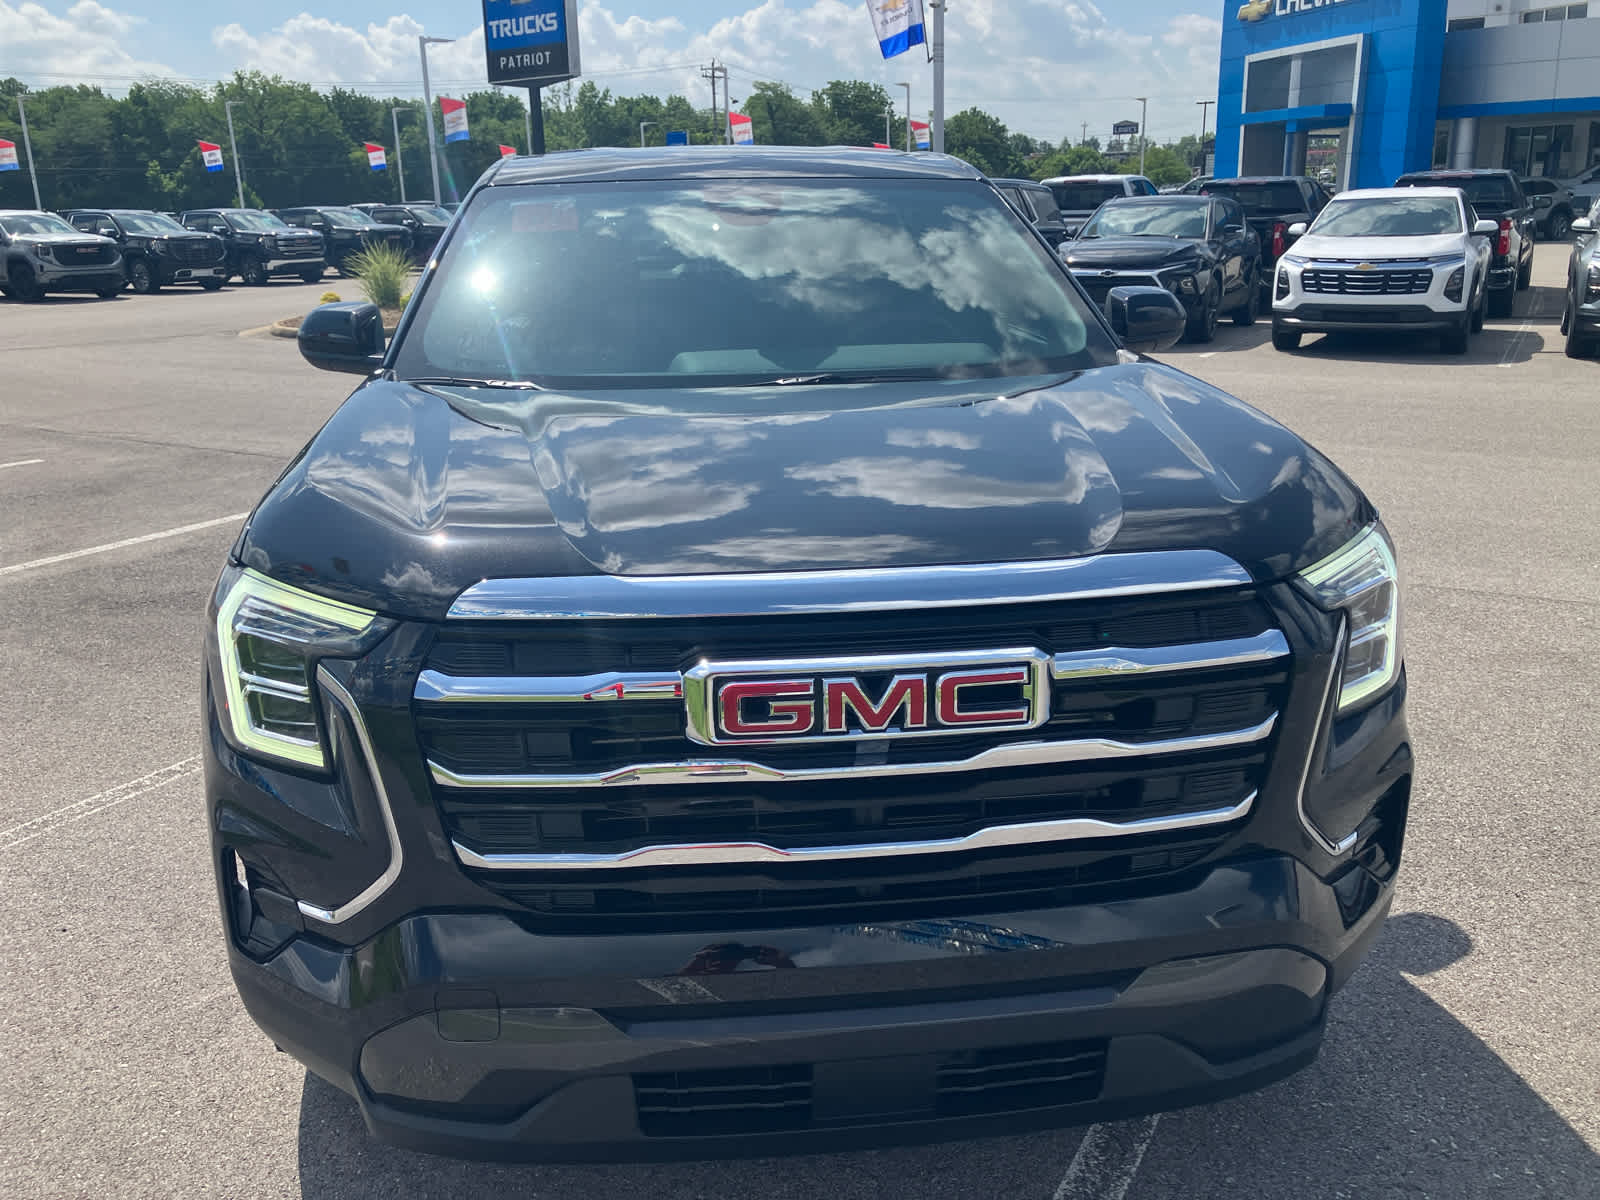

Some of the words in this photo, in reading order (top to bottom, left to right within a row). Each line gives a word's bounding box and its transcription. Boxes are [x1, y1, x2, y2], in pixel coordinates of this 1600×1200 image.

[488, 12, 558, 39] TRUCKS
[500, 51, 551, 69] PATRIOT
[718, 666, 1029, 736] GMC
